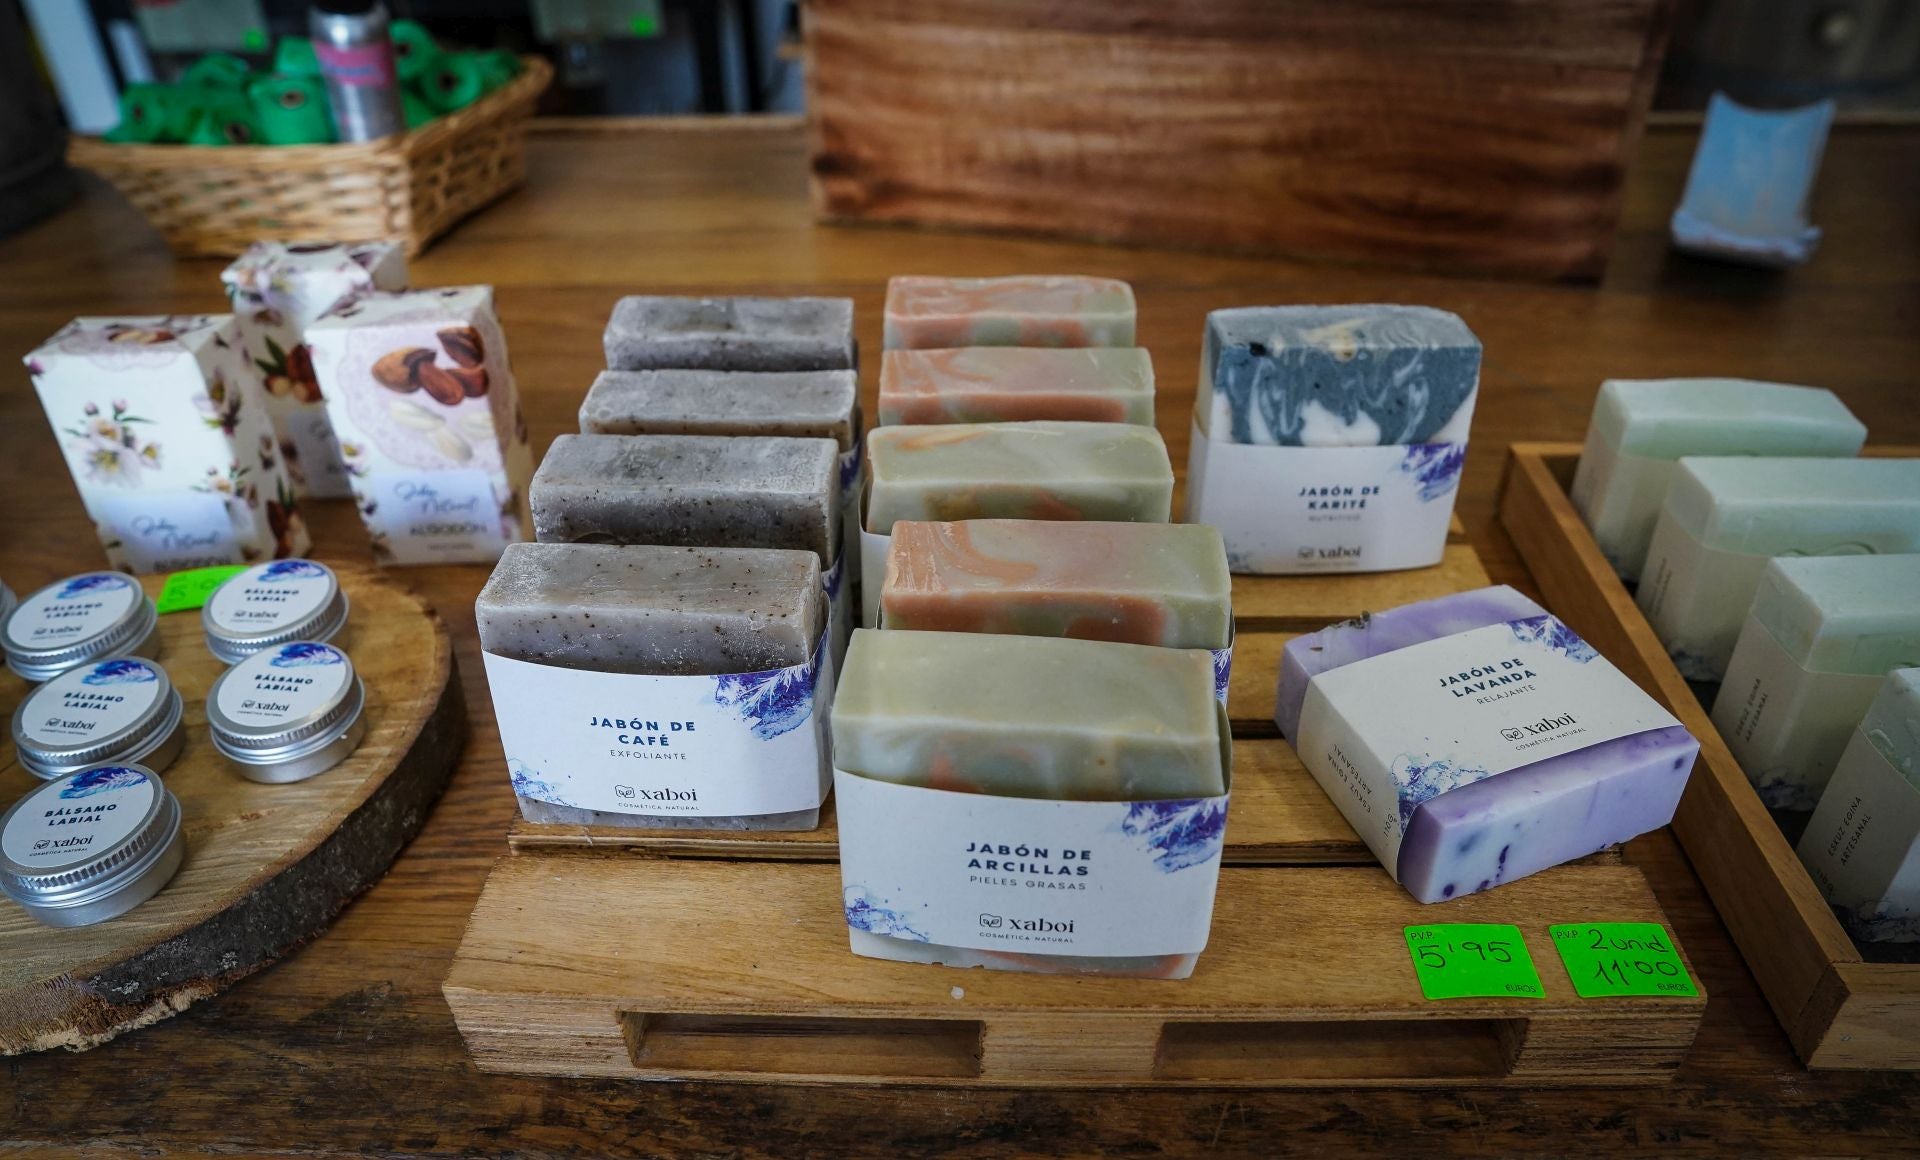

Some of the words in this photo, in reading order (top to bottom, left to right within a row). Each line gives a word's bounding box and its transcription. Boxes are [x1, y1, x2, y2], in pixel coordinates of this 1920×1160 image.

[1300, 486, 1353, 497] JABÓN
[1361, 486, 1381, 496] DE
[1308, 499, 1367, 509] KARITÉ
[254, 673, 313, 685] BÁLSAMO
[1439, 665, 1496, 688] JABÓN
[1502, 658, 1525, 670] DE
[256, 683, 299, 692] LABIAL
[1452, 669, 1537, 698] LAVANDA
[64, 691, 124, 703] BÁLSAMO
[1476, 684, 1536, 706] RELAJANTE
[64, 701, 108, 711] LABIAL
[255, 701, 290, 712] xaboi
[61, 720, 96, 731] xaboi
[590, 716, 659, 731] JABÓN
[670, 720, 696, 732] DE
[1523, 711, 1576, 737] xaboi
[618, 733, 670, 747] CAFÉ
[1555, 726, 1587, 742] NATURAL
[610, 749, 687, 760] EXFOLIANTE
[1333, 744, 1372, 795] ARTESANAL
[639, 787, 698, 801] xaboi
[44, 803, 118, 818] BÁLSAMO
[48, 814, 102, 827] LABIAL
[1828, 826, 1846, 857] ESKUZ
[1843, 796, 1863, 827] EGINA
[52, 835, 94, 848] xaboi
[1840, 813, 1872, 867] ARTESANAL
[966, 842, 1048, 859] JABÓN
[1063, 849, 1092, 861] DE
[967, 858, 1089, 876] ARCILLAS
[969, 875, 1018, 887] PIELES
[1025, 880, 1086, 891] GRASAS
[1009, 917, 1075, 933] xaboi
[1588, 928, 1609, 951] 2
[1418, 941, 1513, 969] 5'95
[1593, 959, 1680, 987] 11'00
